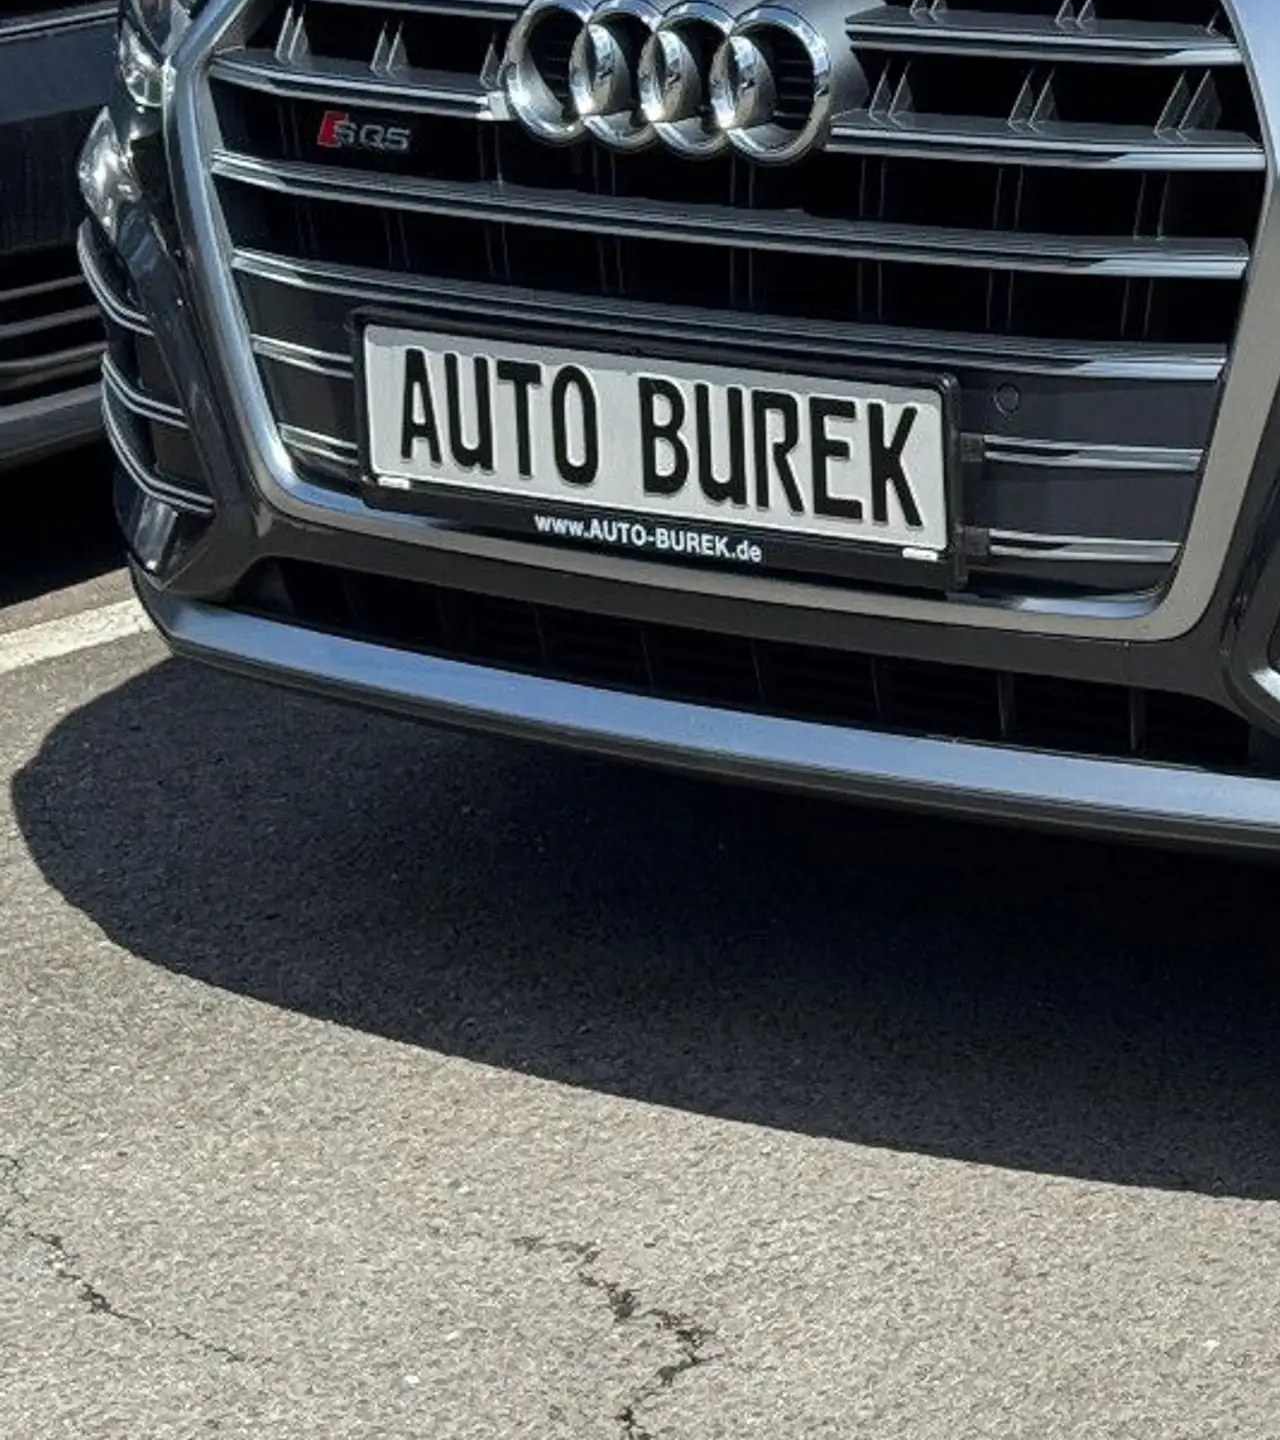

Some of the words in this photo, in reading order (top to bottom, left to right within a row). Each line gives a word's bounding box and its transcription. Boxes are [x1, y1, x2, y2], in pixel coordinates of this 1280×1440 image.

[327, 116, 411, 151] SQ5
[400, 347, 600, 484] AUTO
[637, 376, 923, 528] BUREK
[533, 513, 763, 563] www.AUTO-BUREK.de
